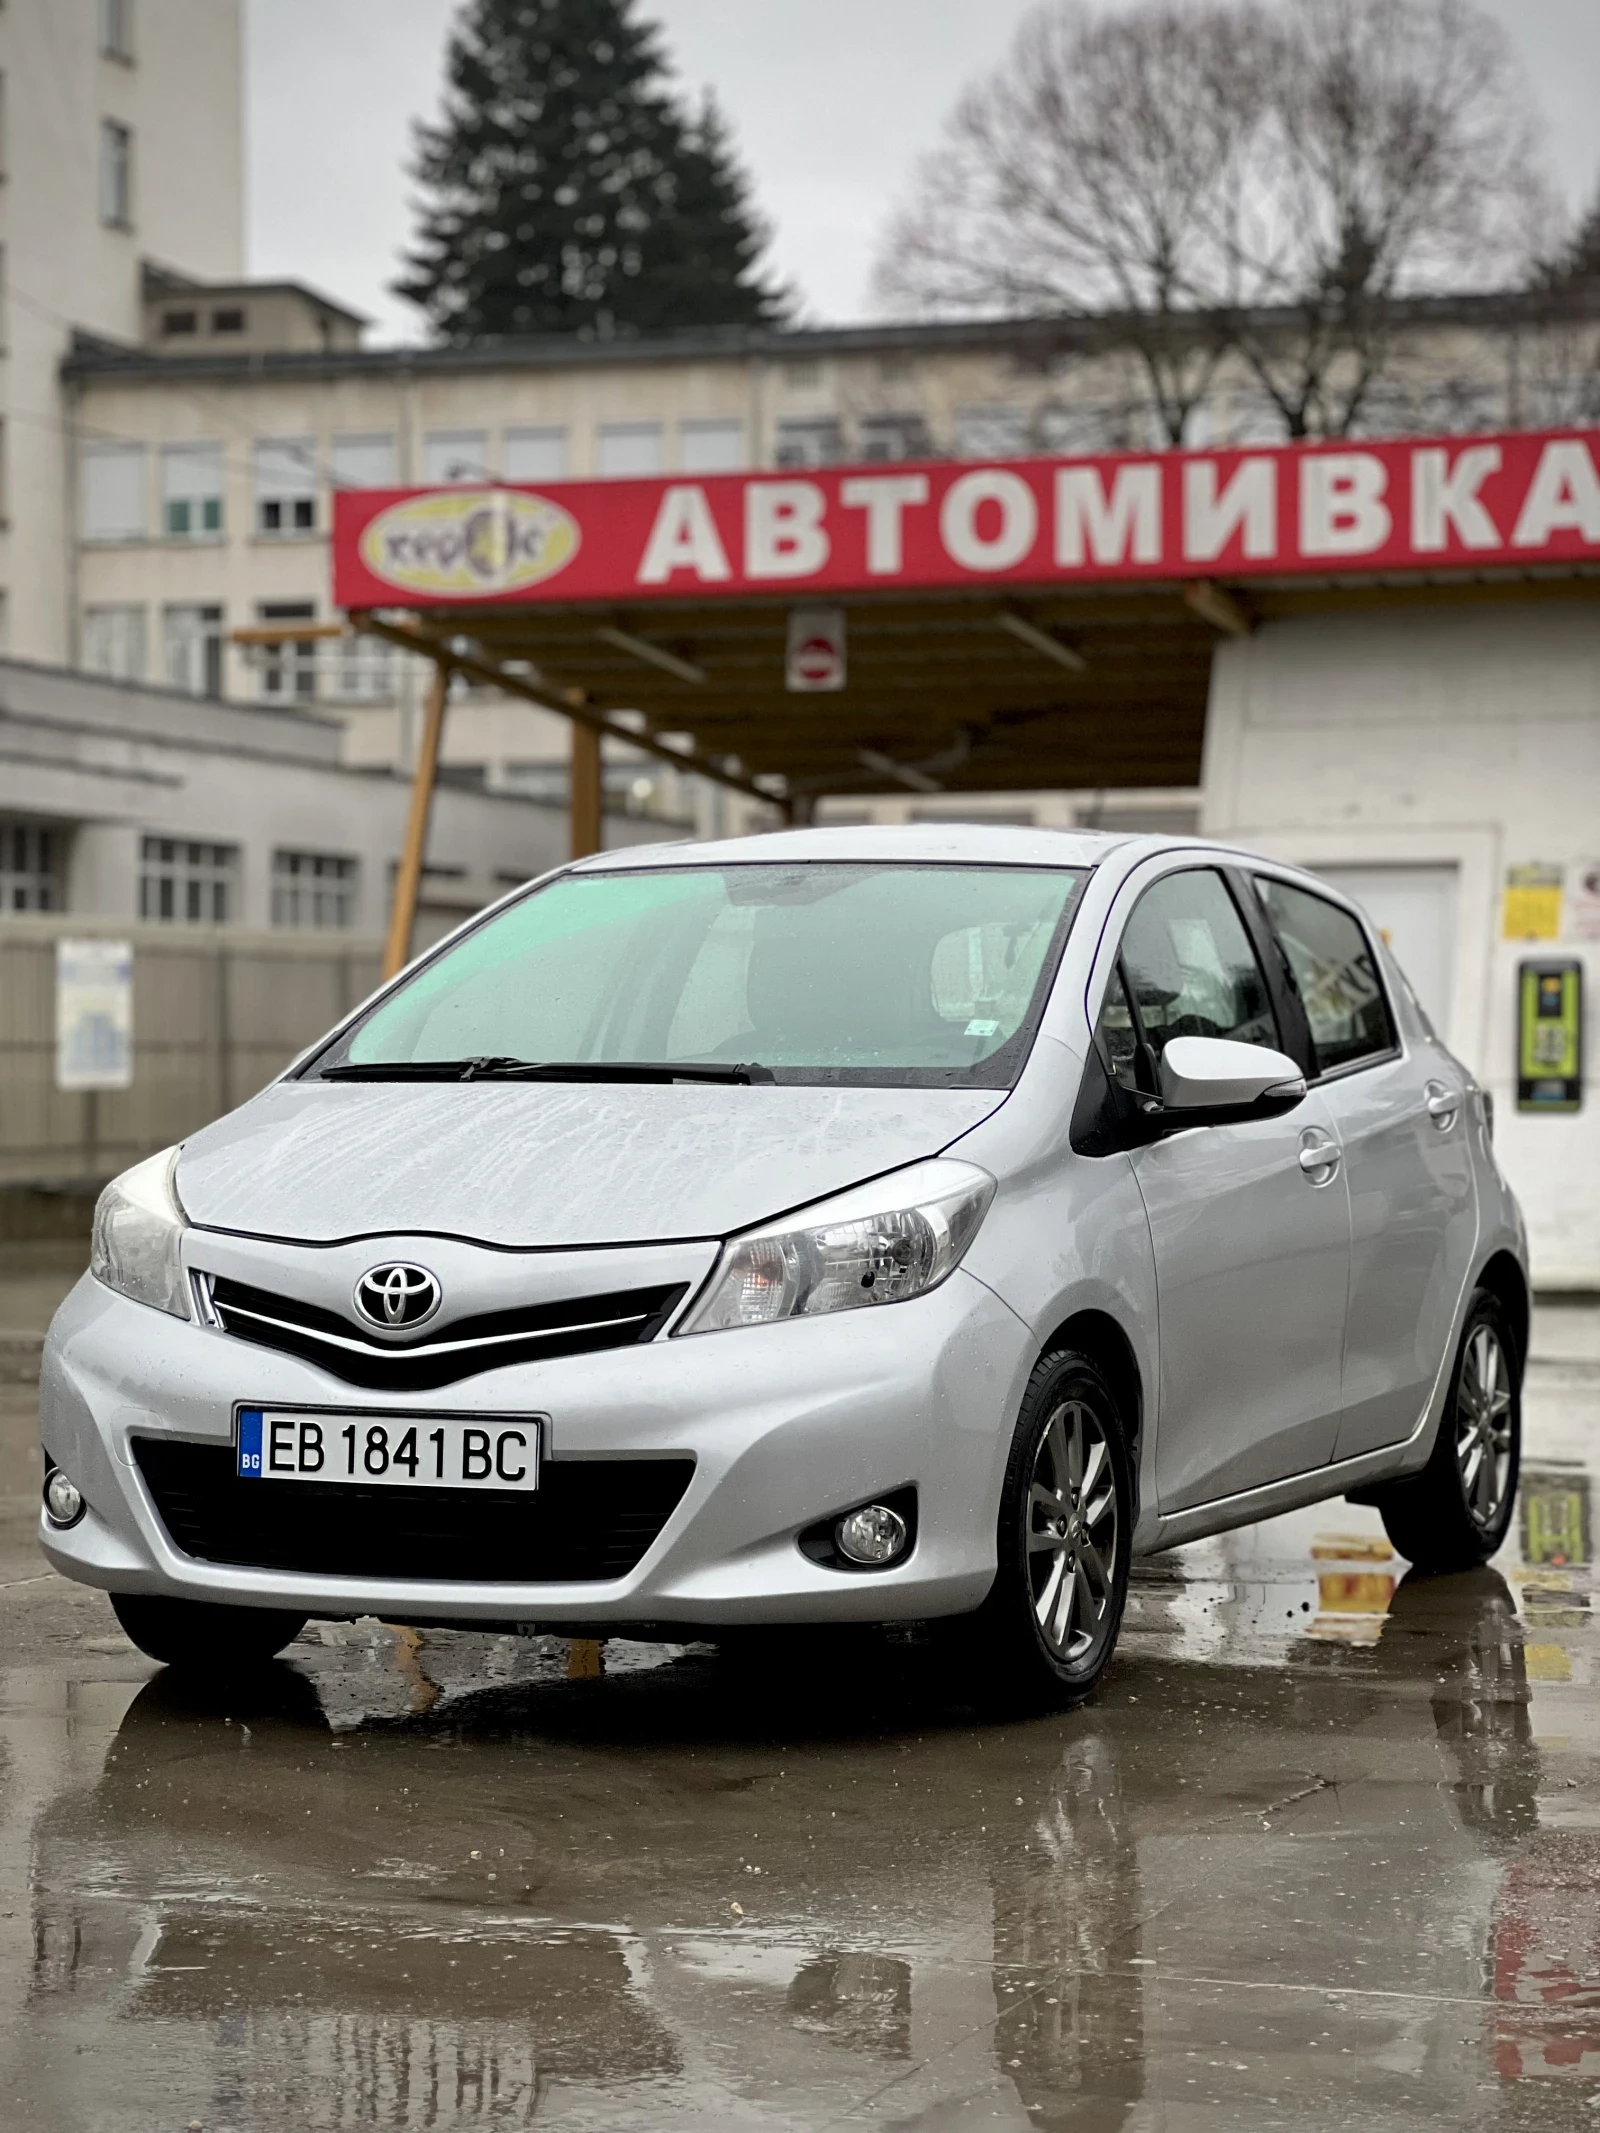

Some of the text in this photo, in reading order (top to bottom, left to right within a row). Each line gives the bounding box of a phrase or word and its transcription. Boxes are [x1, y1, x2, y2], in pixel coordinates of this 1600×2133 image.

[636, 438, 1600, 585] АВТОМИВКА
[242, 1453, 260, 1469] BG
[269, 1420, 527, 1482] EB 1841 BC
